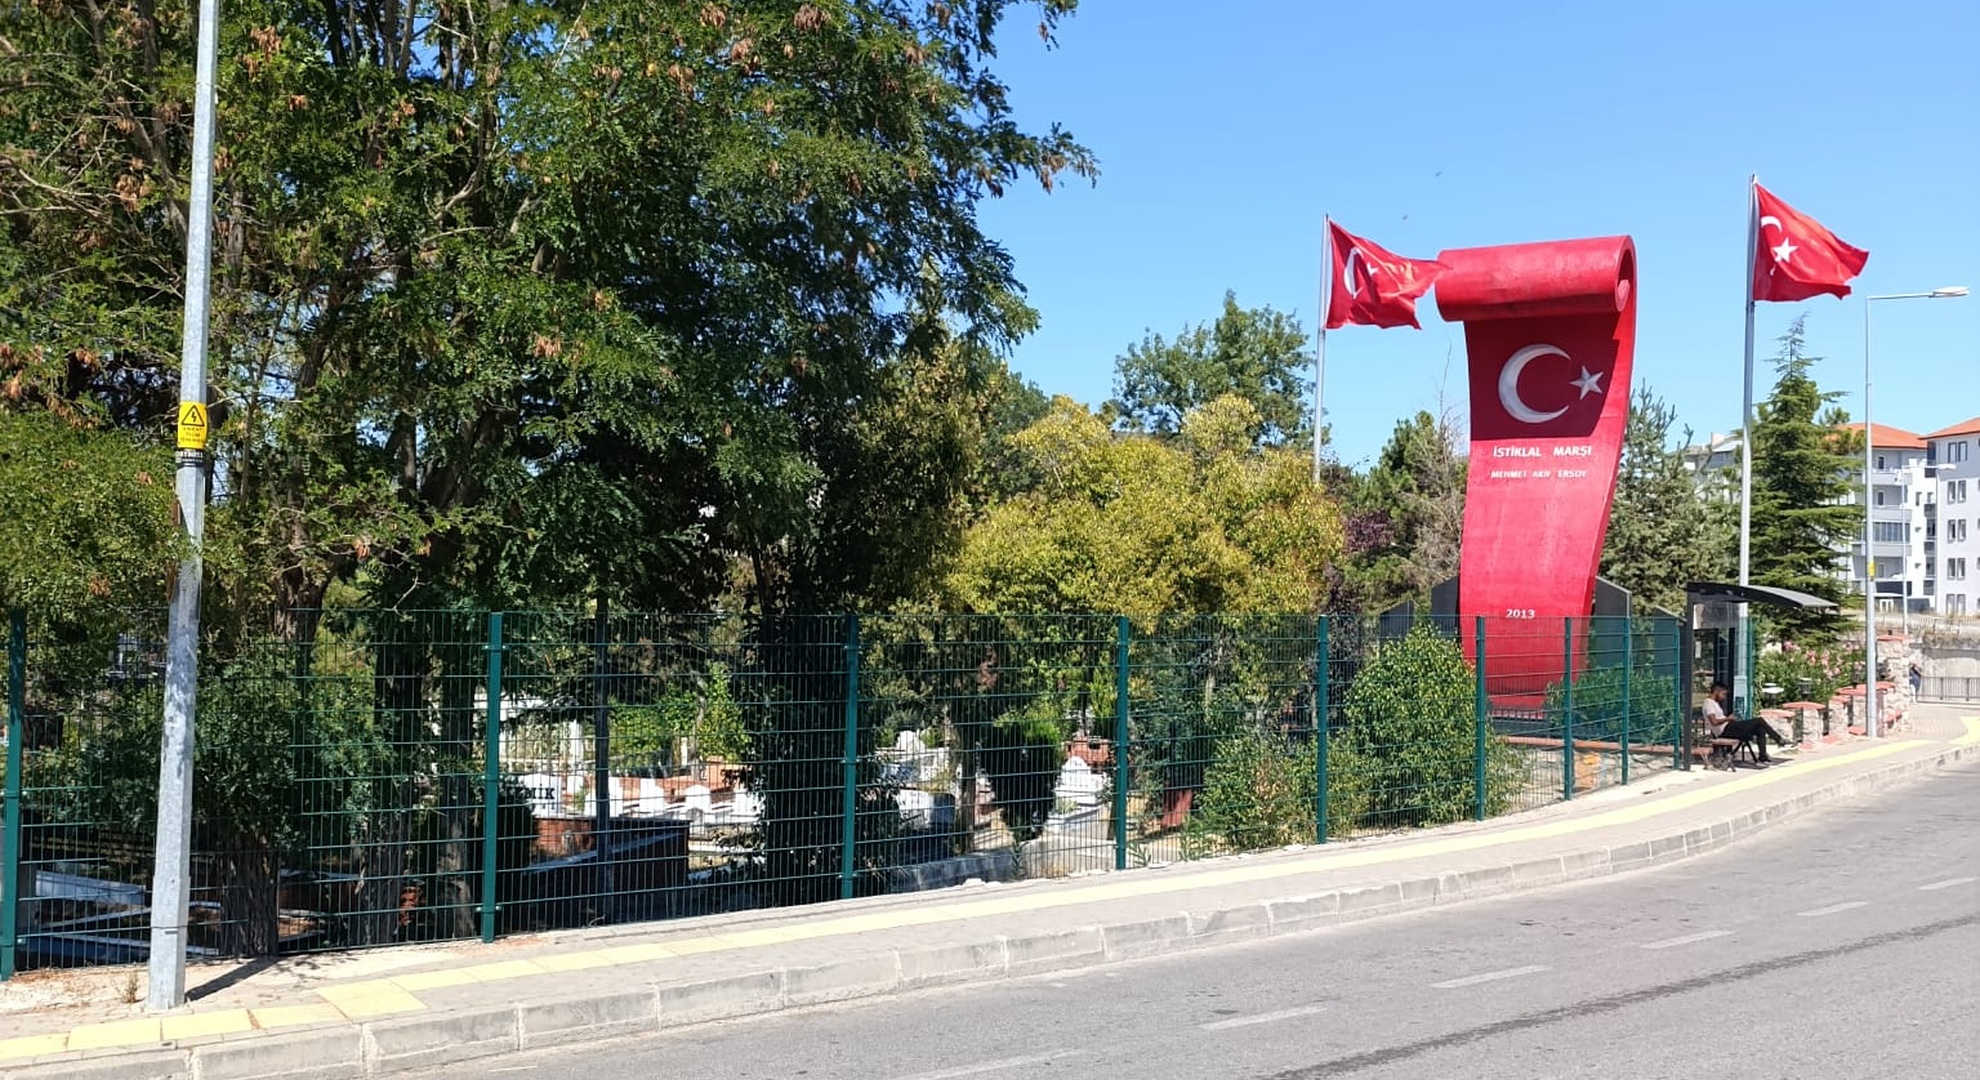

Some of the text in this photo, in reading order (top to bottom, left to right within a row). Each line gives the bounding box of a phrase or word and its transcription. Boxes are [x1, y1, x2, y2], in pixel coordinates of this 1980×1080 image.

[1493, 445, 1592, 458] İSTİKLAL MARŞI
[1506, 608, 1535, 619] 2013
